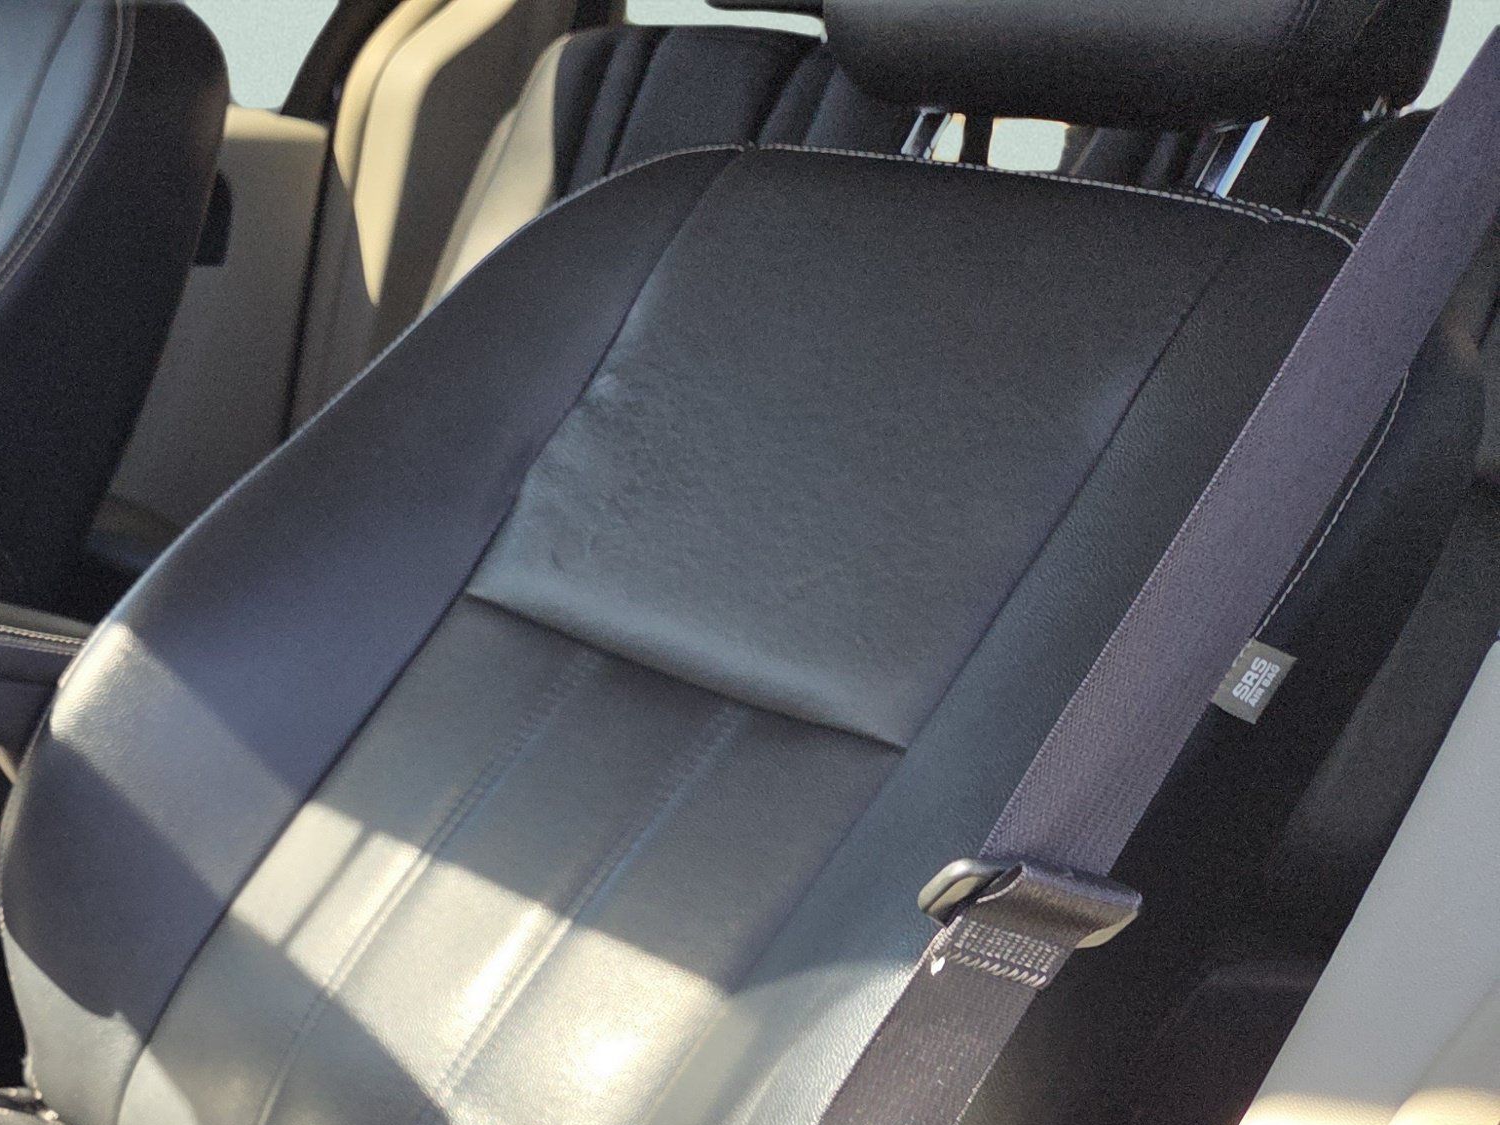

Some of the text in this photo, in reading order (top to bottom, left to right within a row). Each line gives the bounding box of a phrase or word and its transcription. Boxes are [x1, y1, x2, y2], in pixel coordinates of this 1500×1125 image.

[1232, 657, 1268, 700] SRS
[1248, 664, 1280, 707] AIR BAG
